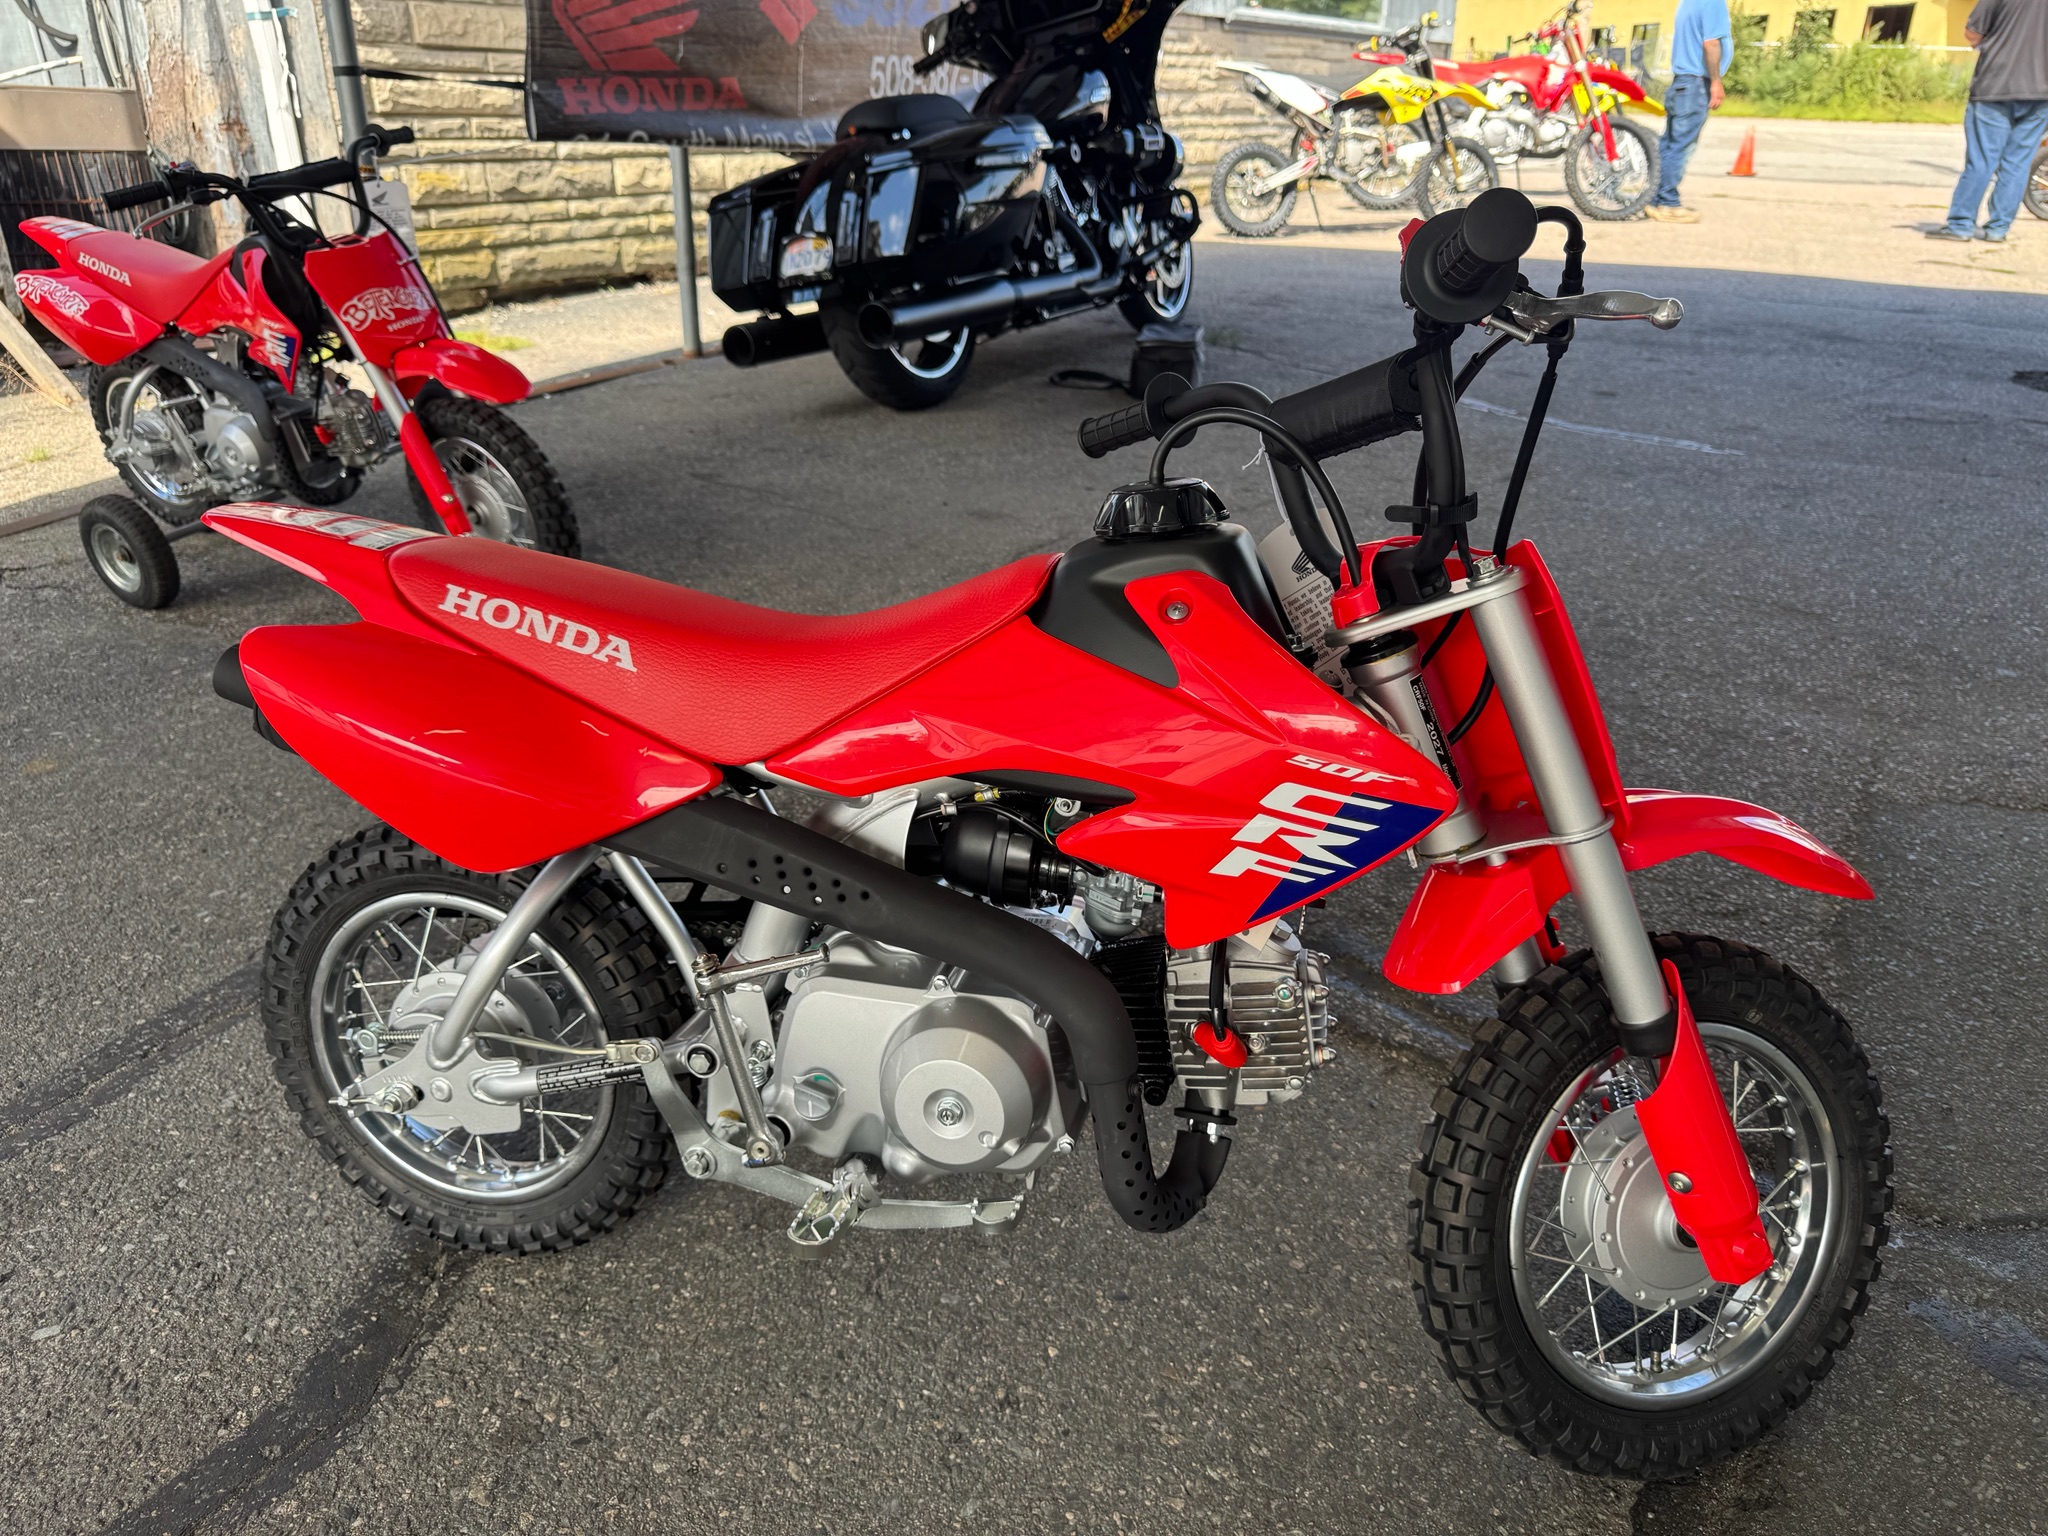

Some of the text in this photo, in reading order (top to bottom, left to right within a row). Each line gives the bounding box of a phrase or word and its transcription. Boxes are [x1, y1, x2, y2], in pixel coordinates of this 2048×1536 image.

[556, 76, 748, 115] HONDA
[77, 252, 132, 287] HONDA
[1296, 567, 1318, 583] HOND
[438, 583, 637, 673] HONDA
[1426, 722, 1445, 756] 2027
[1286, 754, 1408, 784] 50F
[1208, 782, 1393, 884] CRF
